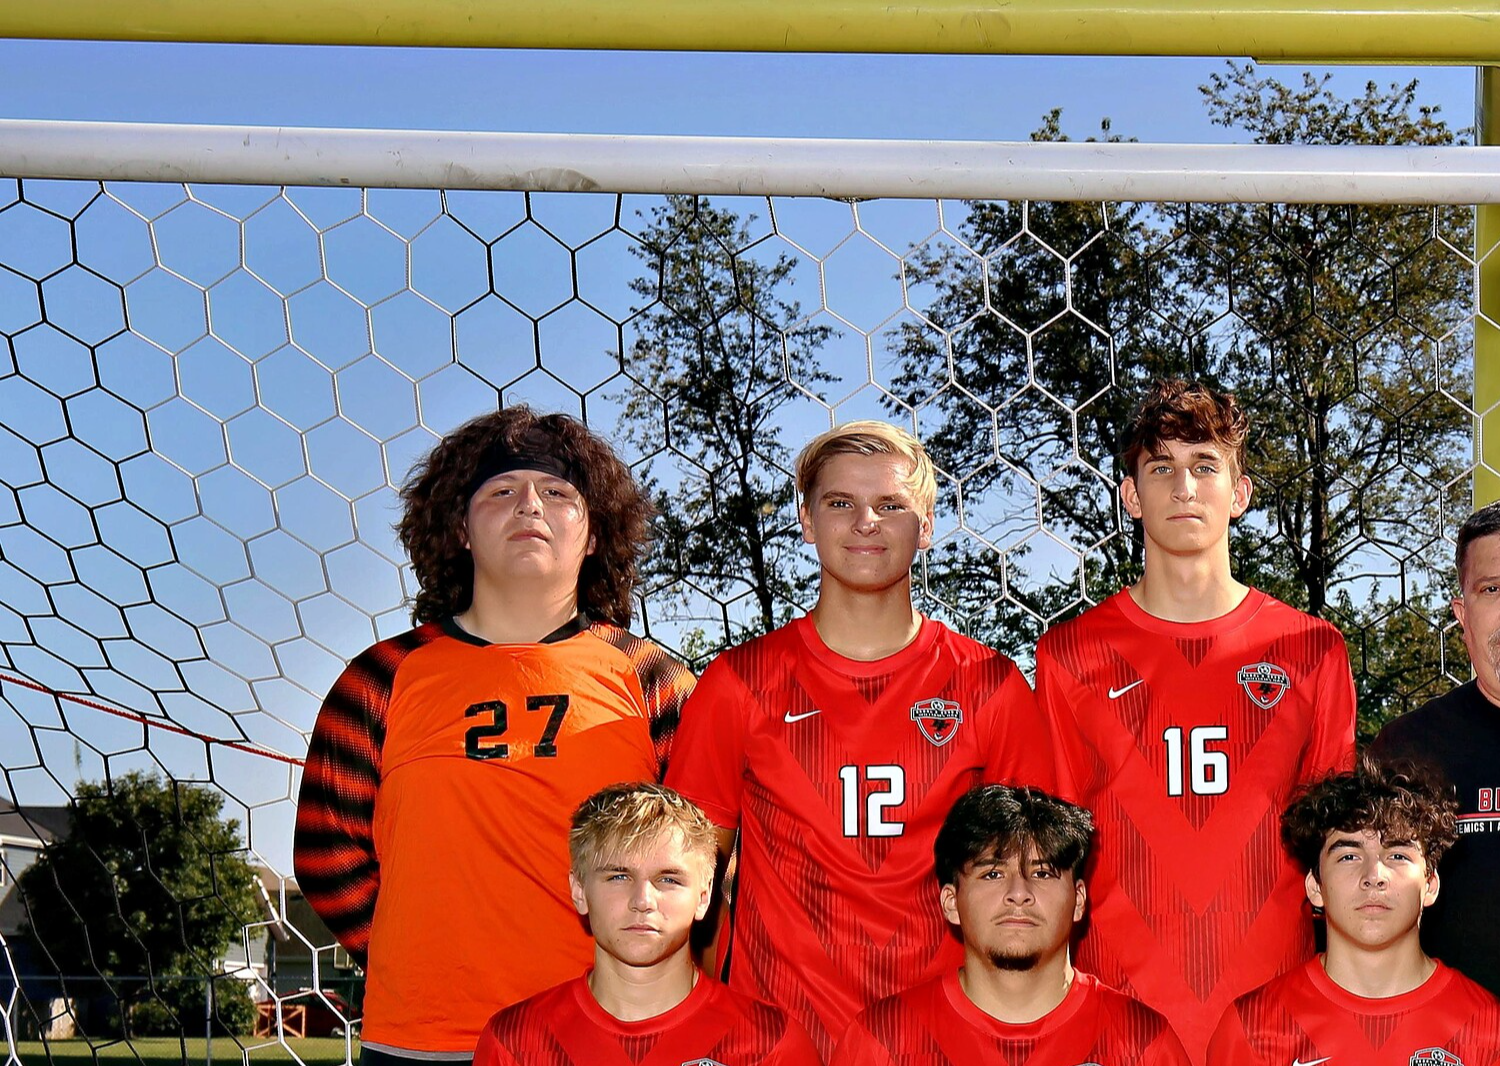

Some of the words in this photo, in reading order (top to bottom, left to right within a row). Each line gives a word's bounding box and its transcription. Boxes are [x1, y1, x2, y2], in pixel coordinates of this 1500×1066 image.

[464, 692, 570, 762] 27
[1162, 725, 1230, 798] 16
[838, 763, 906, 838] 12
